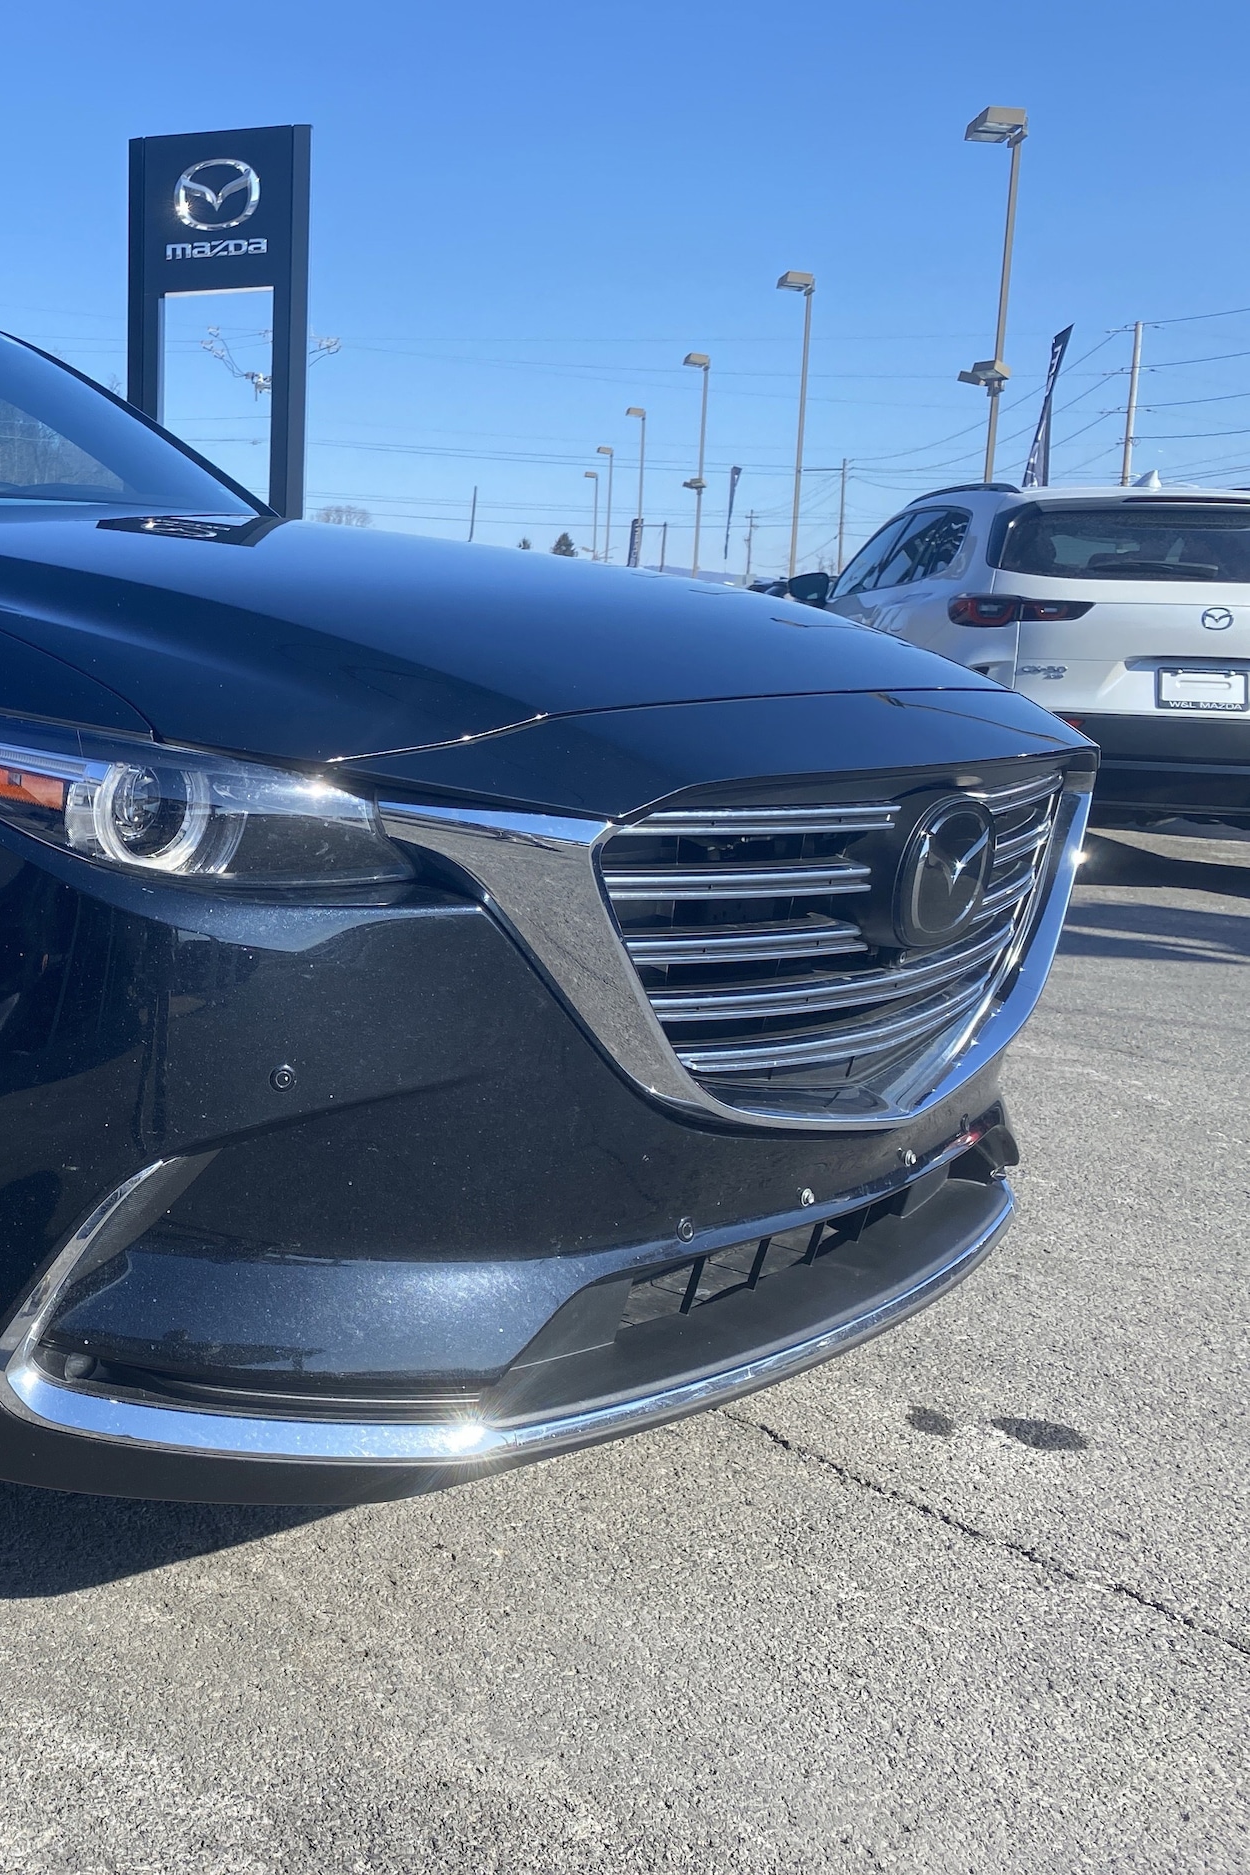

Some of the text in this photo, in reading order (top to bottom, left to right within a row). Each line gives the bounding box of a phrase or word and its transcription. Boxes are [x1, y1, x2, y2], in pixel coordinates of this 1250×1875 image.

[166, 238, 268, 260] mazda
[1169, 700, 1243, 711] W&L MAZDA
